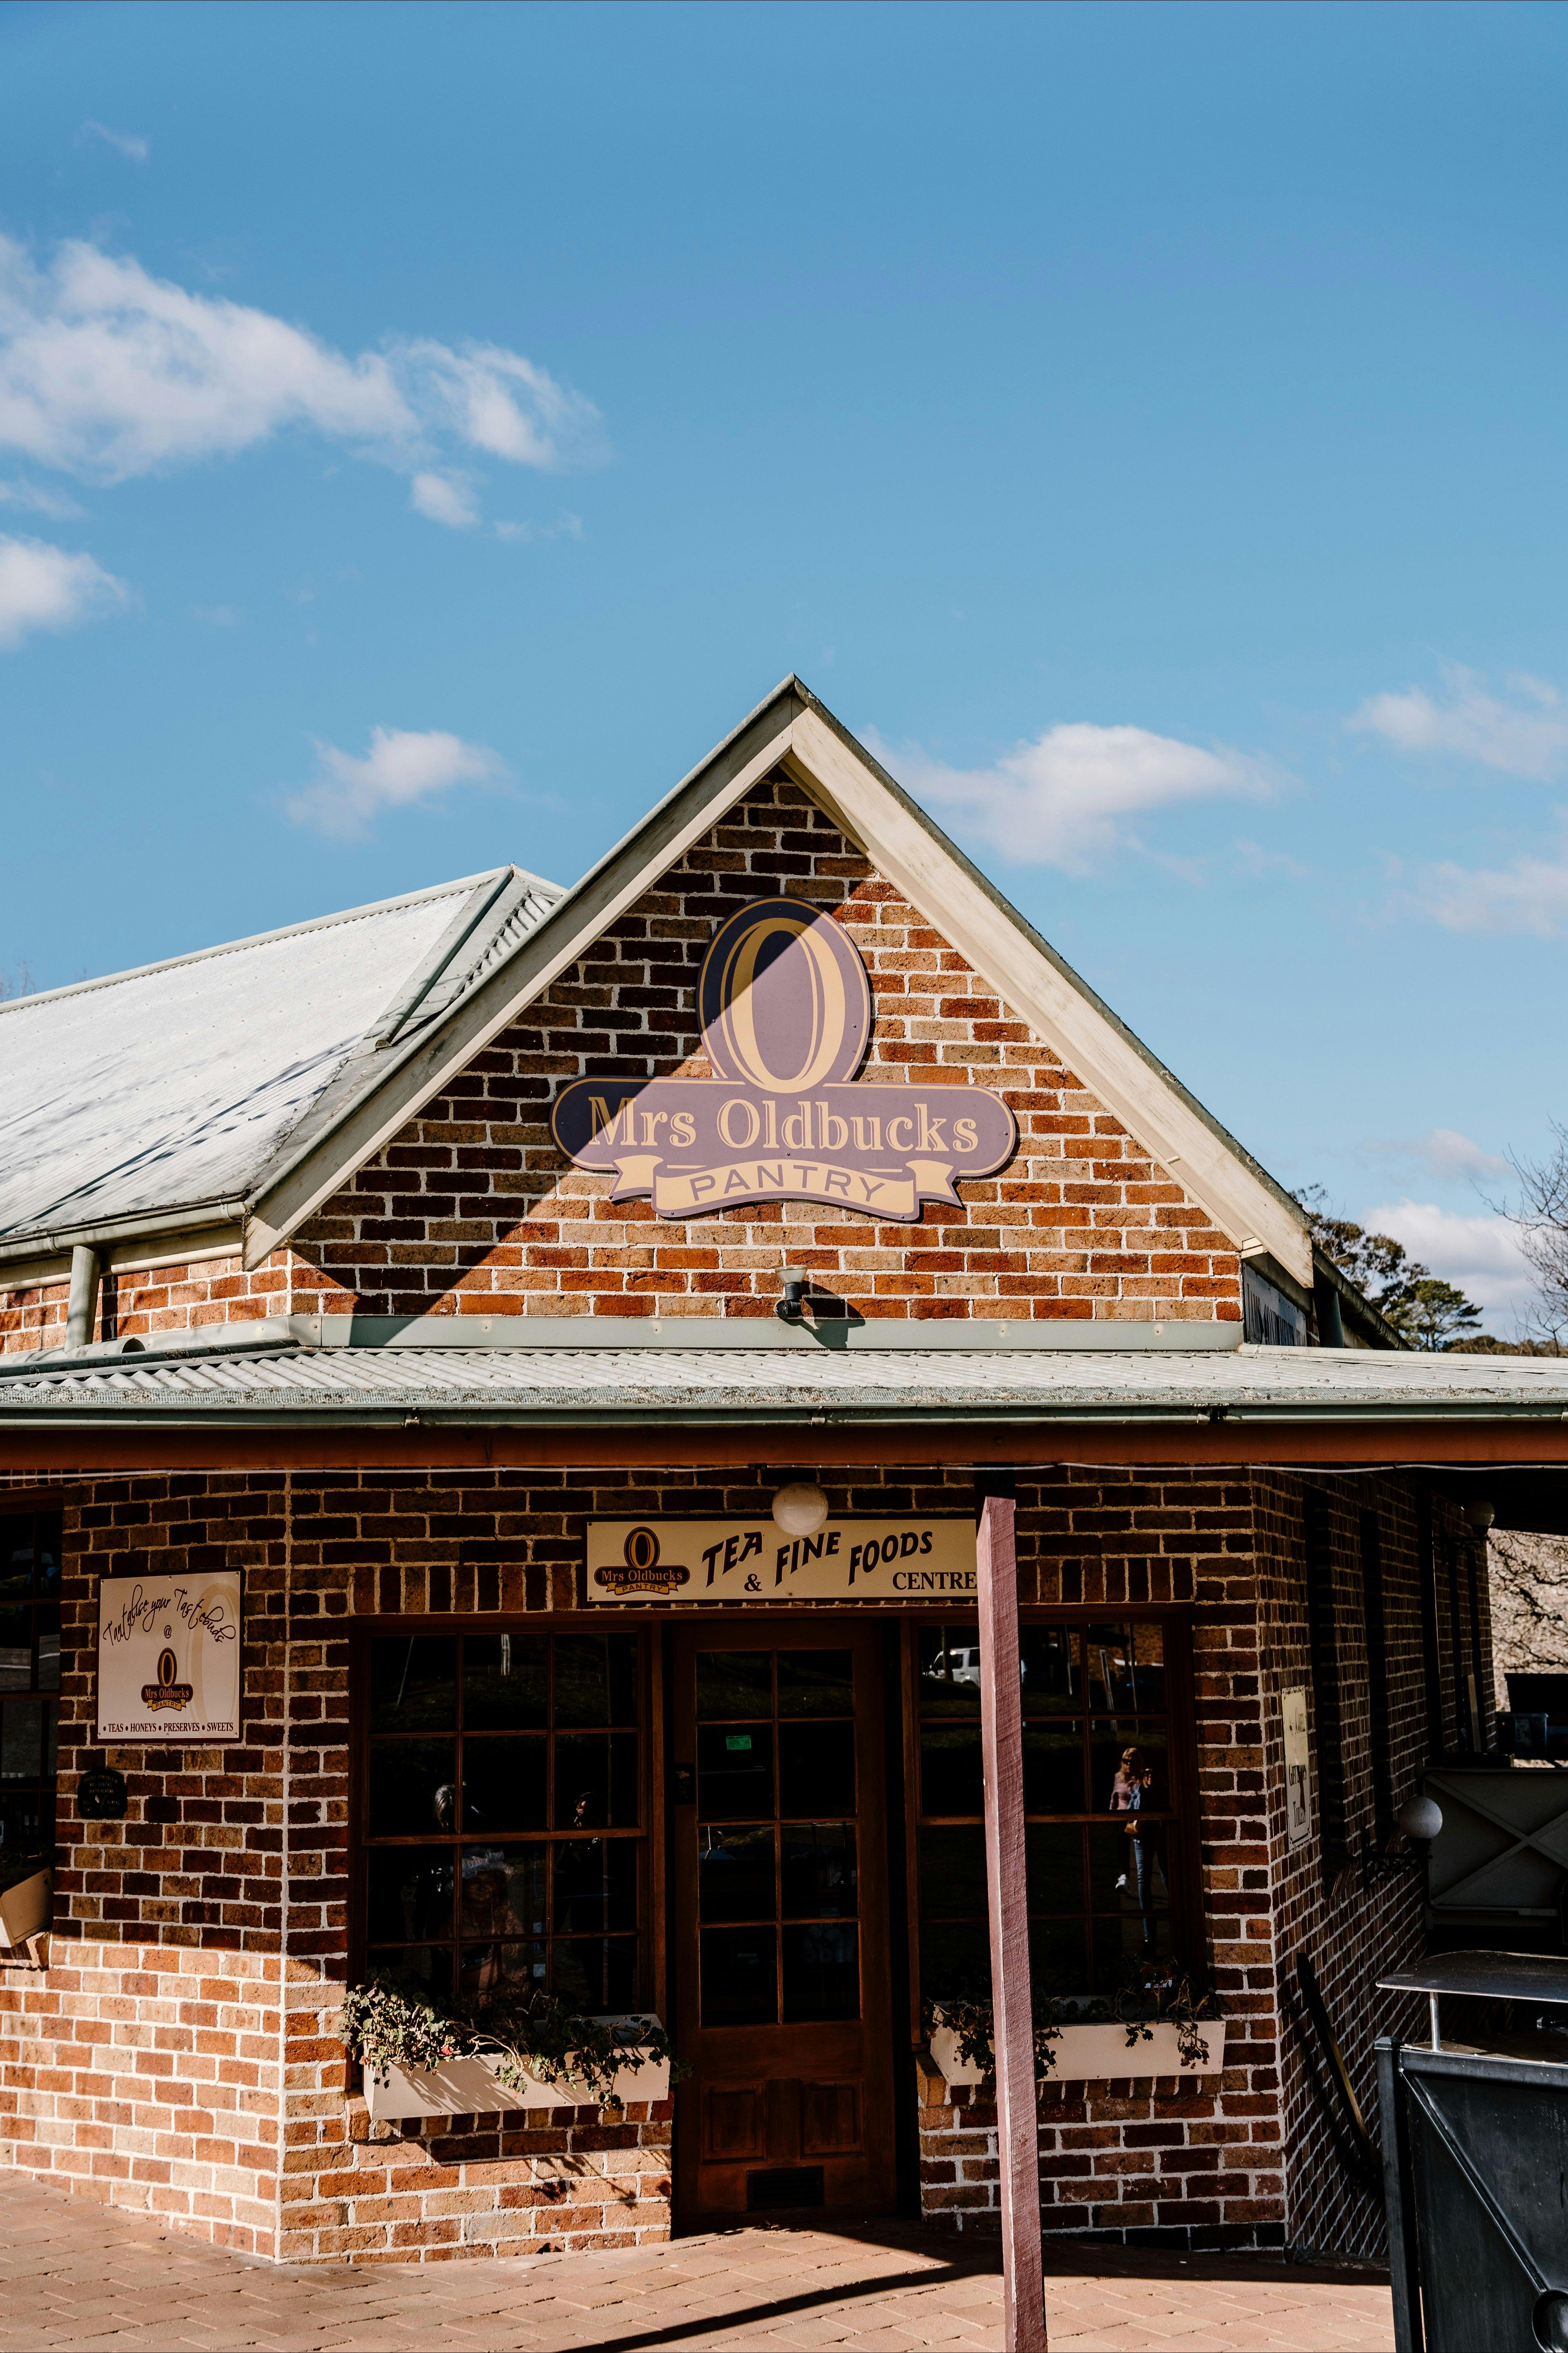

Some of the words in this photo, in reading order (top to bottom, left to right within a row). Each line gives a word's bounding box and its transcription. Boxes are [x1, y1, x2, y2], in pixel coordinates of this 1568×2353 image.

[721, 917, 846, 1094] O
[588, 1097, 696, 1146] Mrs
[717, 1098, 979, 1153] Oldbucks
[690, 1164, 886, 1203] PANTRY
[629, 1531, 655, 1569] O
[702, 1531, 762, 1588] TEA
[744, 1573, 762, 1592] &
[775, 1532, 841, 1587] FINE
[848, 1531, 933, 1587] FOODS
[602, 1571, 624, 1581] Mrs
[628, 1570, 682, 1581] Oldbucks
[892, 1571, 977, 1590] CENTRE
[622, 1584, 663, 1592] PANTRY
[103, 1584, 149, 1645] Tantalise
[143, 1597, 171, 1632] your
[164, 1625, 172, 1639] @
[145, 1688, 157, 1699] Mrs
[159, 1687, 189, 1698] Oldbucks
[156, 1701, 178, 1709] PANTRY
[108, 1723, 123, 1732] TEAS
[130, 1723, 156, 1732] HONEYS
[164, 1722, 200, 1732] PRESERVES
[207, 1722, 233, 1732] SWEETS
